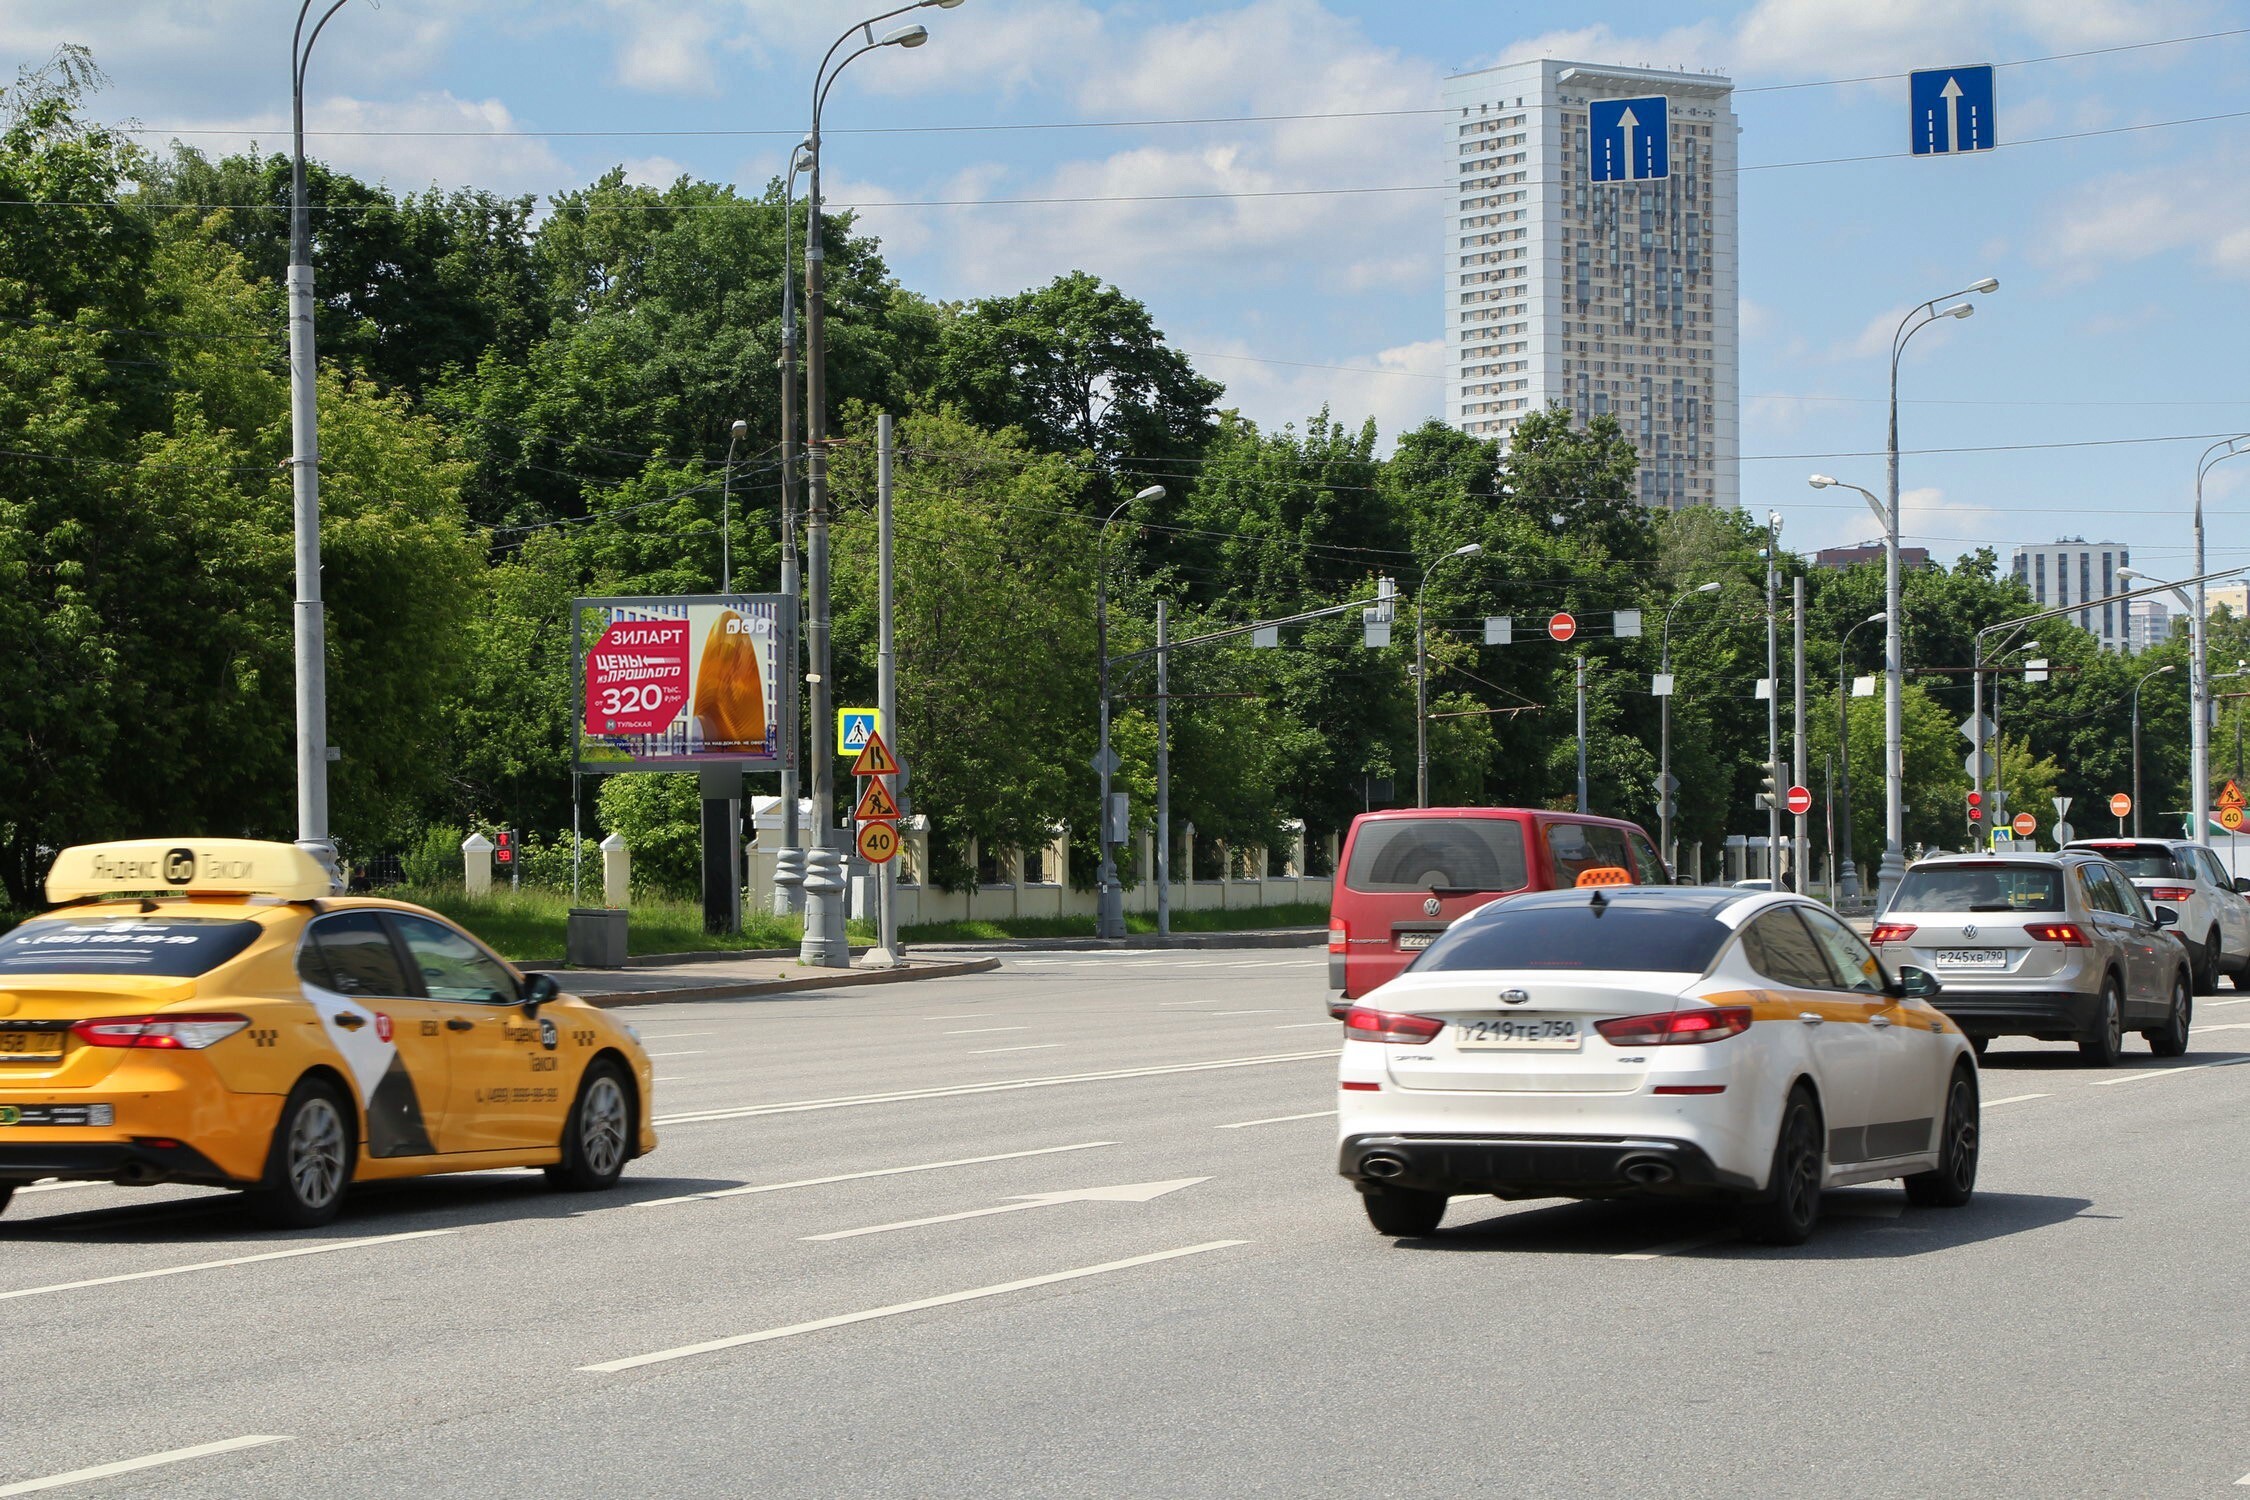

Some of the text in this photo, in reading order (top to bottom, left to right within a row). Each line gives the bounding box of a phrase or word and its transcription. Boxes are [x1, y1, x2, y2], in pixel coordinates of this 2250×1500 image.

[611, 630, 683, 645] ЗИЛАРТ
[595, 654, 643, 671] ЦЕНЫ
[608, 666, 681, 683] ПРОШЛОГО
[601, 684, 662, 715] 320
[2225, 813, 2239, 822] 40
[866, 834, 890, 850] 40
[90, 852, 253, 882] Яндекс Go Такси
